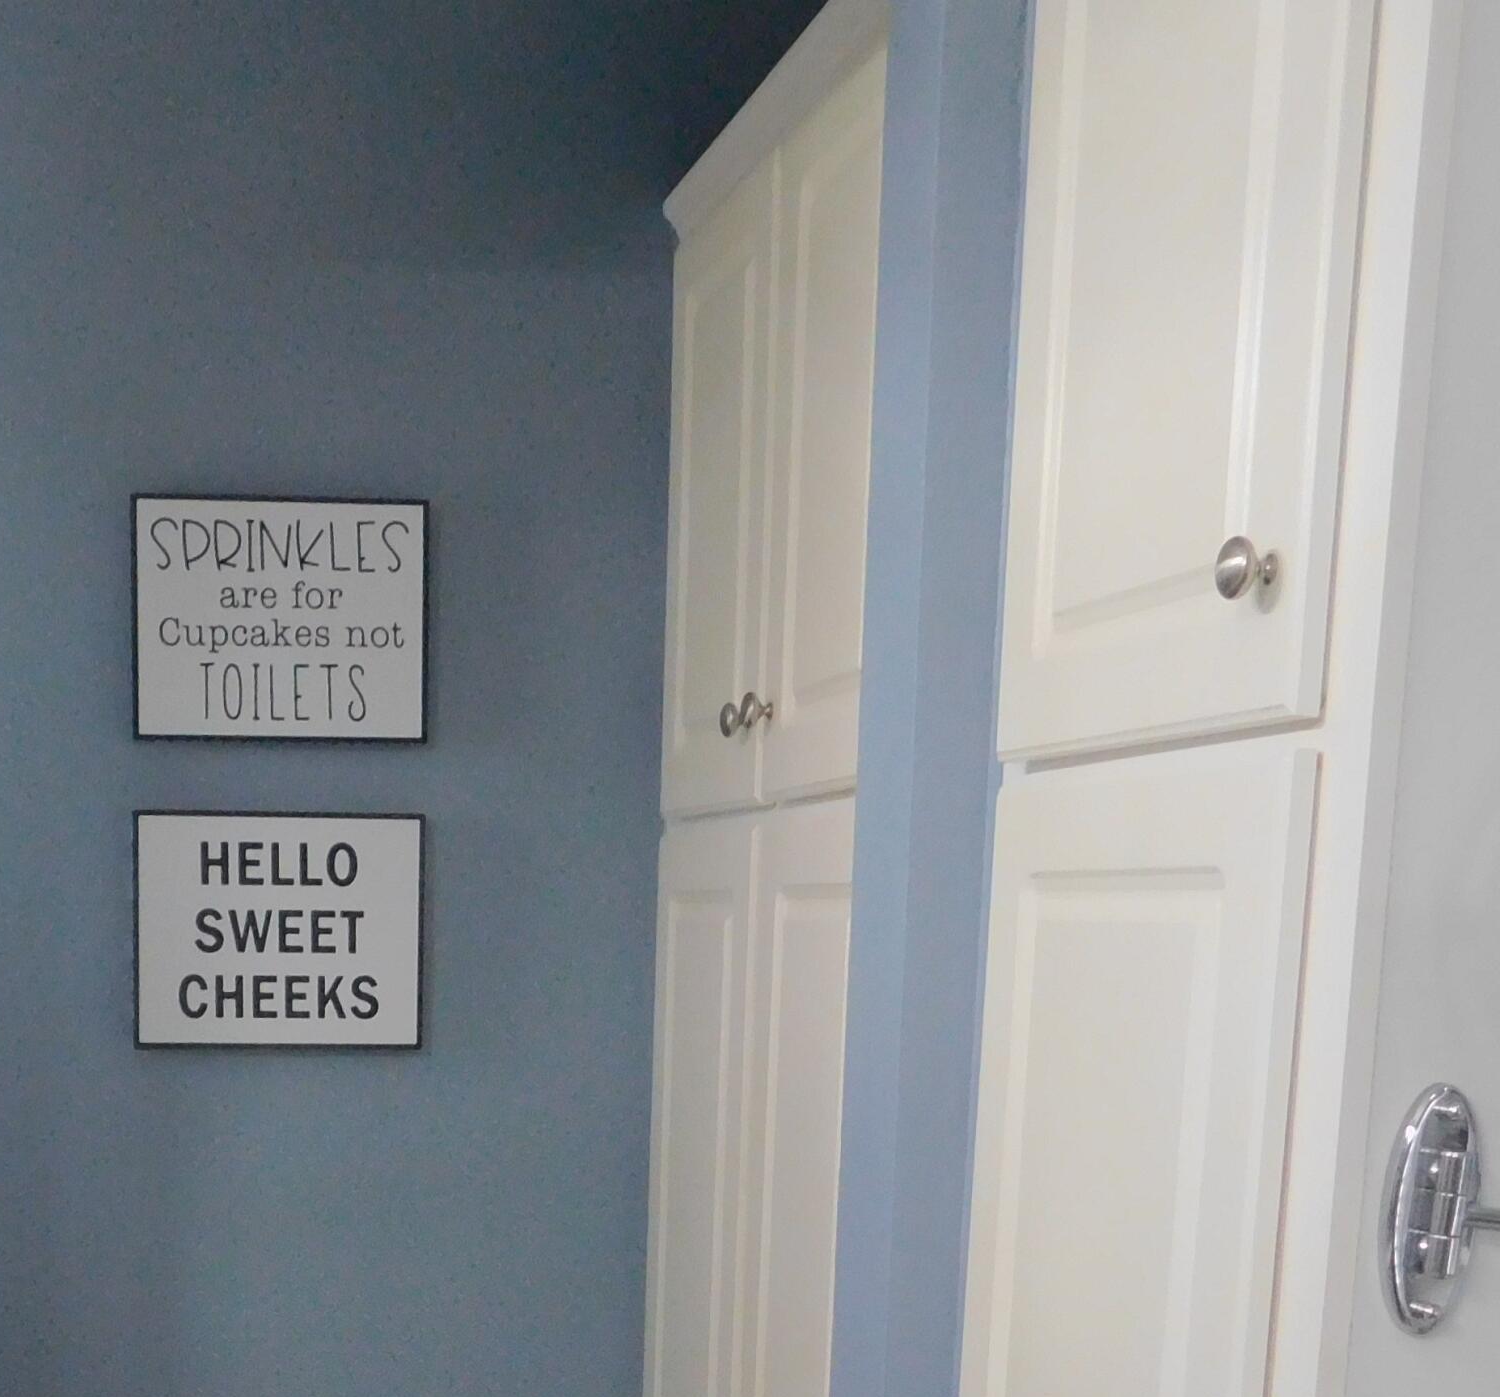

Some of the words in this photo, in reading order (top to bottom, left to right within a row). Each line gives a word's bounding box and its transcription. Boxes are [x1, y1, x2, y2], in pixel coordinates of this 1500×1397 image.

[150, 517, 409, 573] SPRINKLES
[220, 587, 277, 609] are
[292, 580, 343, 609] for
[159, 617, 330, 653] Cupcakes
[346, 622, 404, 648] not
[200, 662, 366, 722] TOILETS
[200, 841, 358, 887] HELLO
[195, 908, 364, 954] SWEET
[179, 974, 379, 1019] CHEEKS
